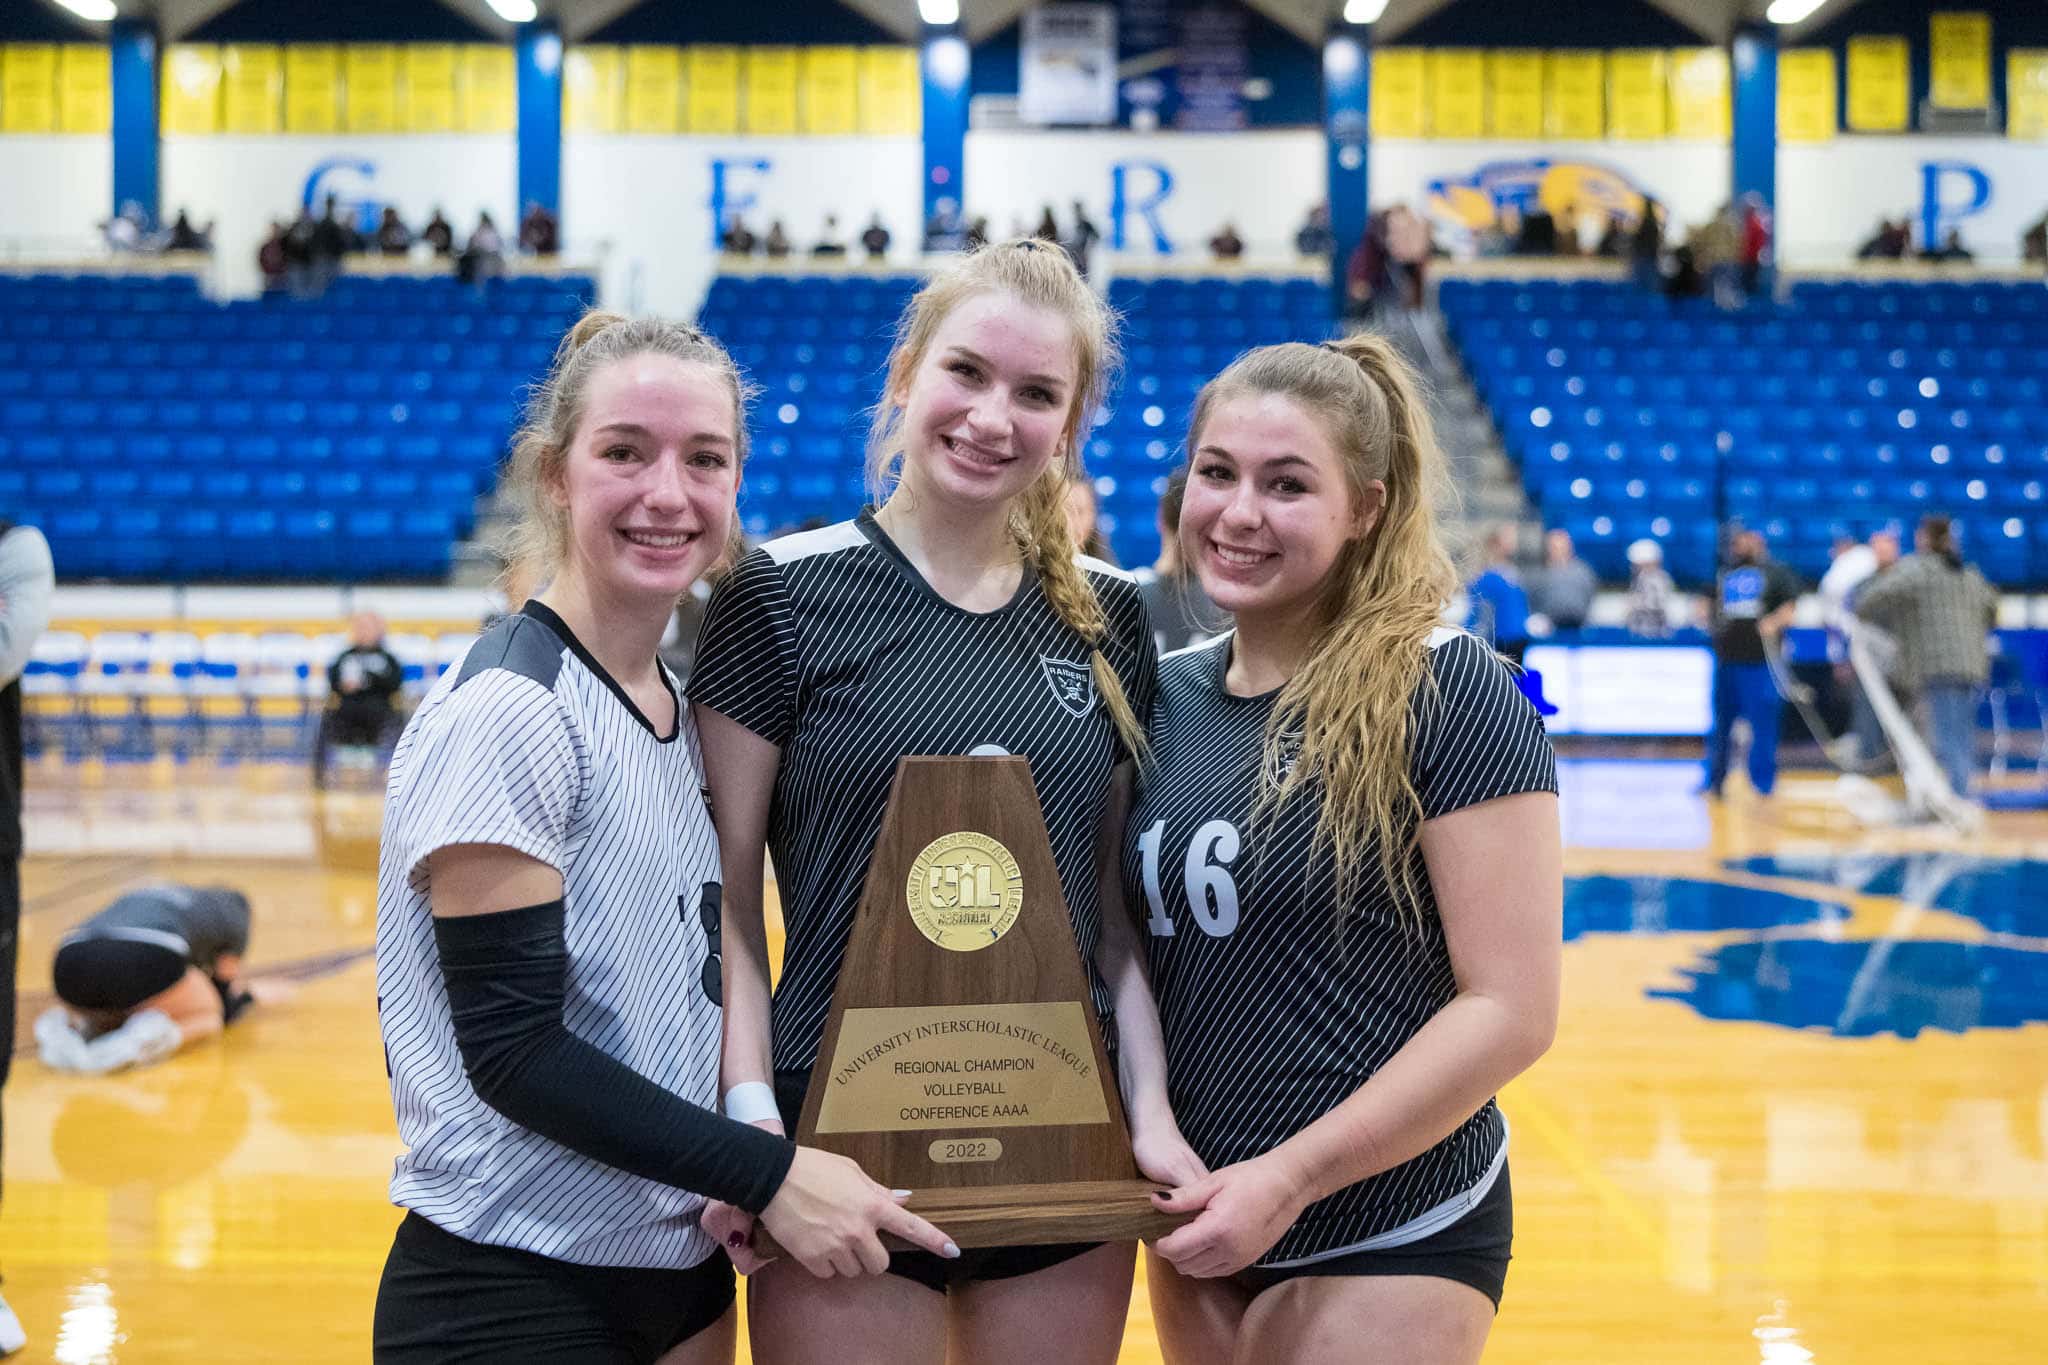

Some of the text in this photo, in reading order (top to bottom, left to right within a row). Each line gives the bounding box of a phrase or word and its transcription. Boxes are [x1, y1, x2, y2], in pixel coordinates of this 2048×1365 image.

[1108, 158, 1173, 253] R
[1920, 160, 1991, 251] P
[1049, 667, 1088, 682] RAIDERS
[1138, 819, 1240, 938] 16
[835, 1019, 1092, 1086] UNIVERSITY INTERSCHOLASTIC LEAGUE
[894, 1058, 1034, 1074] REGIONAL CHAMPION
[924, 1082, 1005, 1096] VOLLEYBALL
[900, 1104, 1029, 1120] CONFERENCE AAAA
[946, 1143, 986, 1158] 2022
